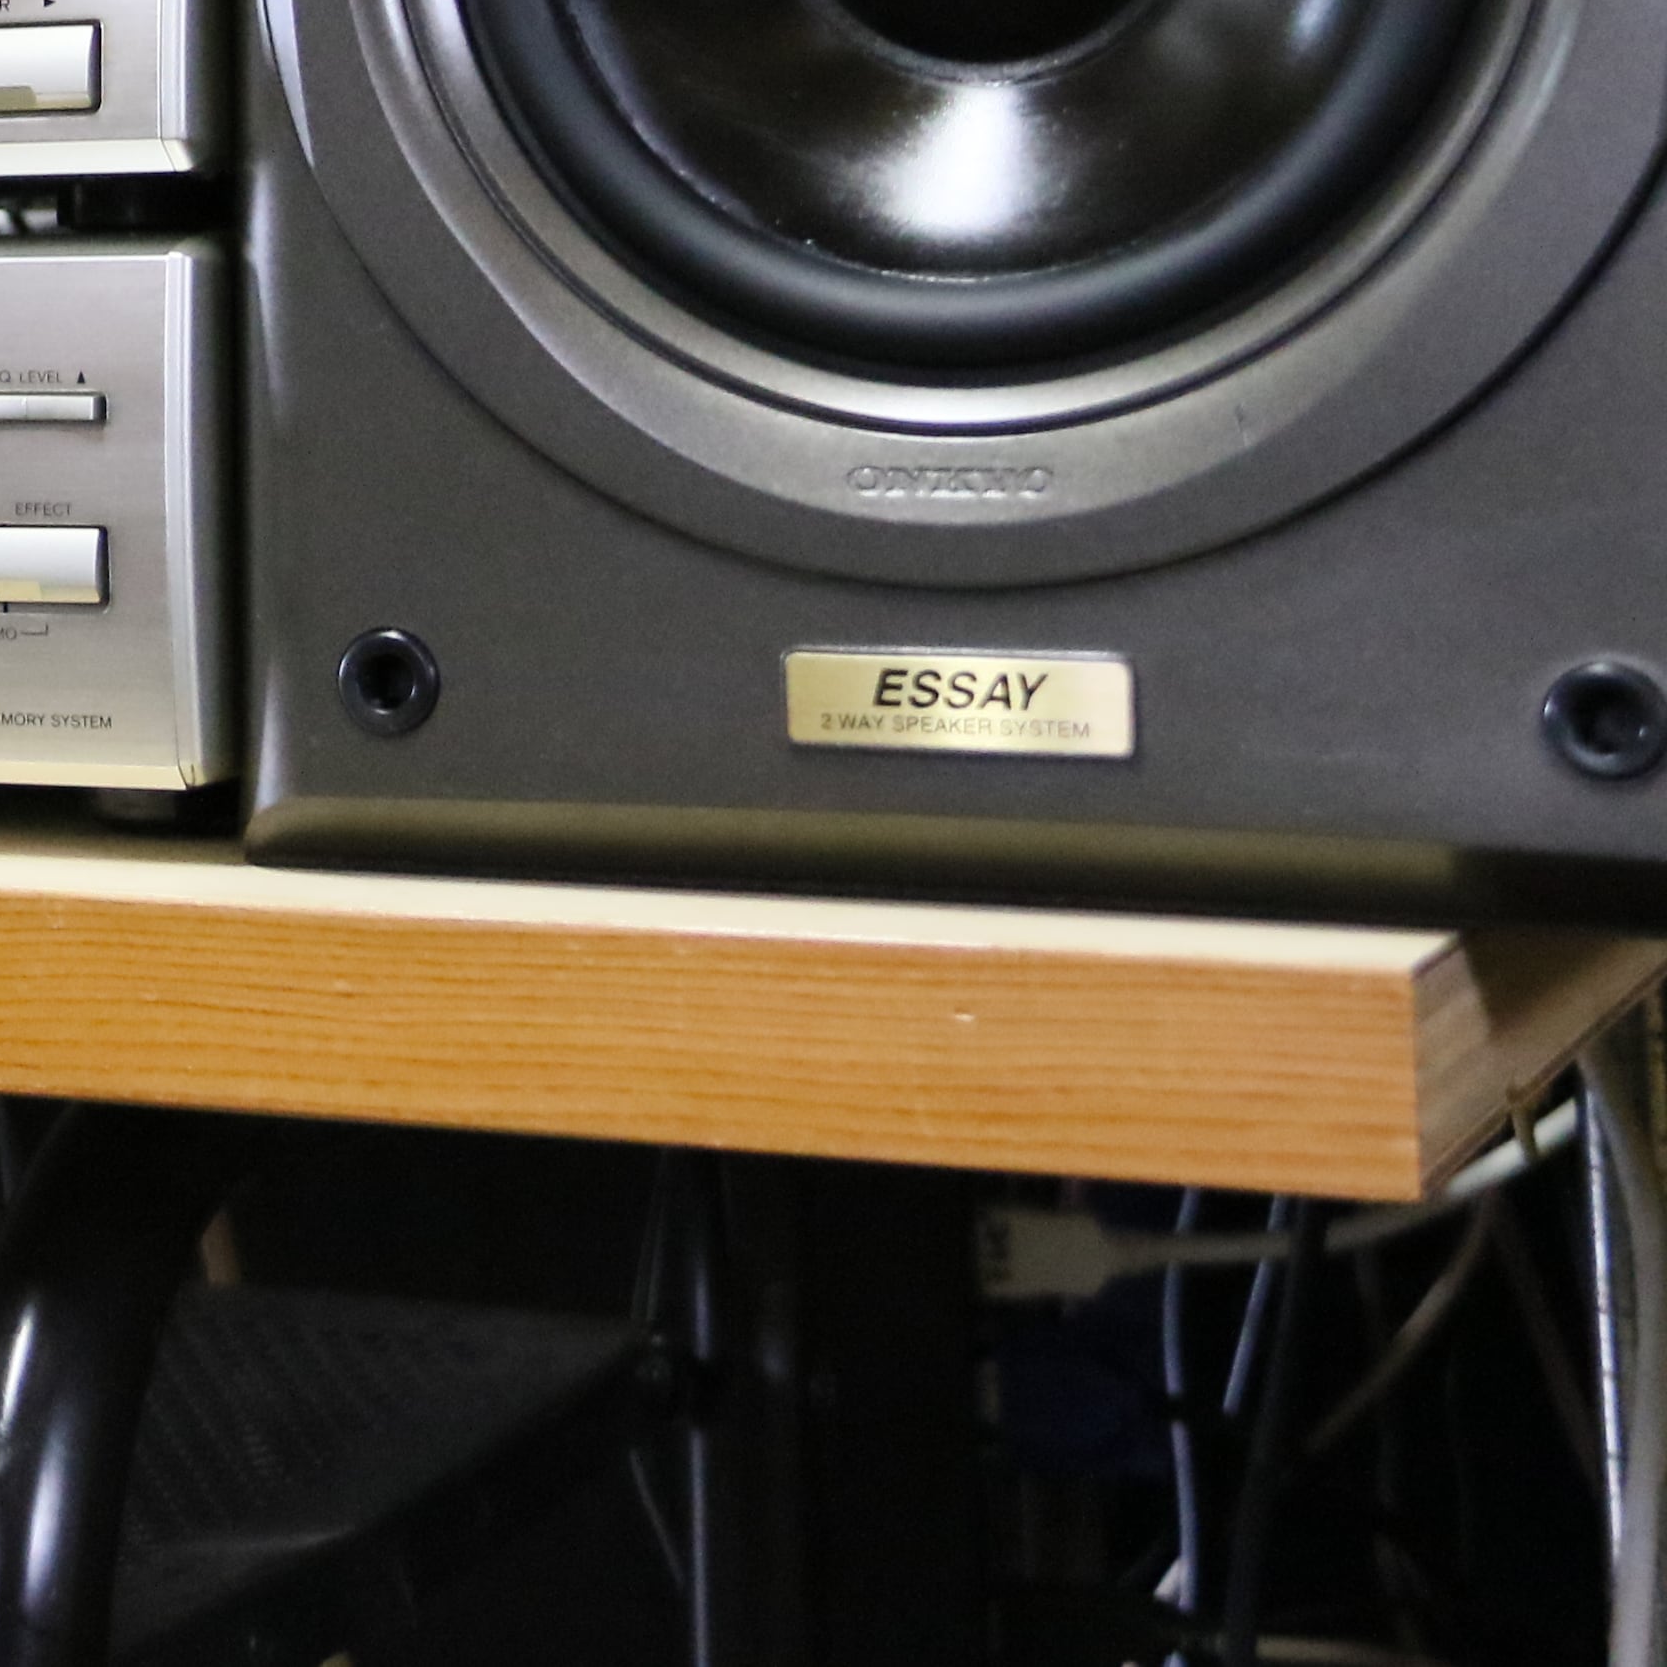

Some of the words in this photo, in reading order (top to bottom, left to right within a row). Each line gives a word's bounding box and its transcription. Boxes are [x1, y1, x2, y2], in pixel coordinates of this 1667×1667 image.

[19, 370, 63, 383] LEVEL
[846, 464, 1055, 500] ONKYO
[14, 502, 73, 516] EFFECT
[872, 667, 1049, 711] ESSAY
[51, 713, 113, 729] SYSTEM
[820, 712, 834, 731] 2
[838, 713, 886, 732] WAY
[891, 716, 993, 737] SPEAKER
[1000, 718, 1092, 739] SYSTEM
